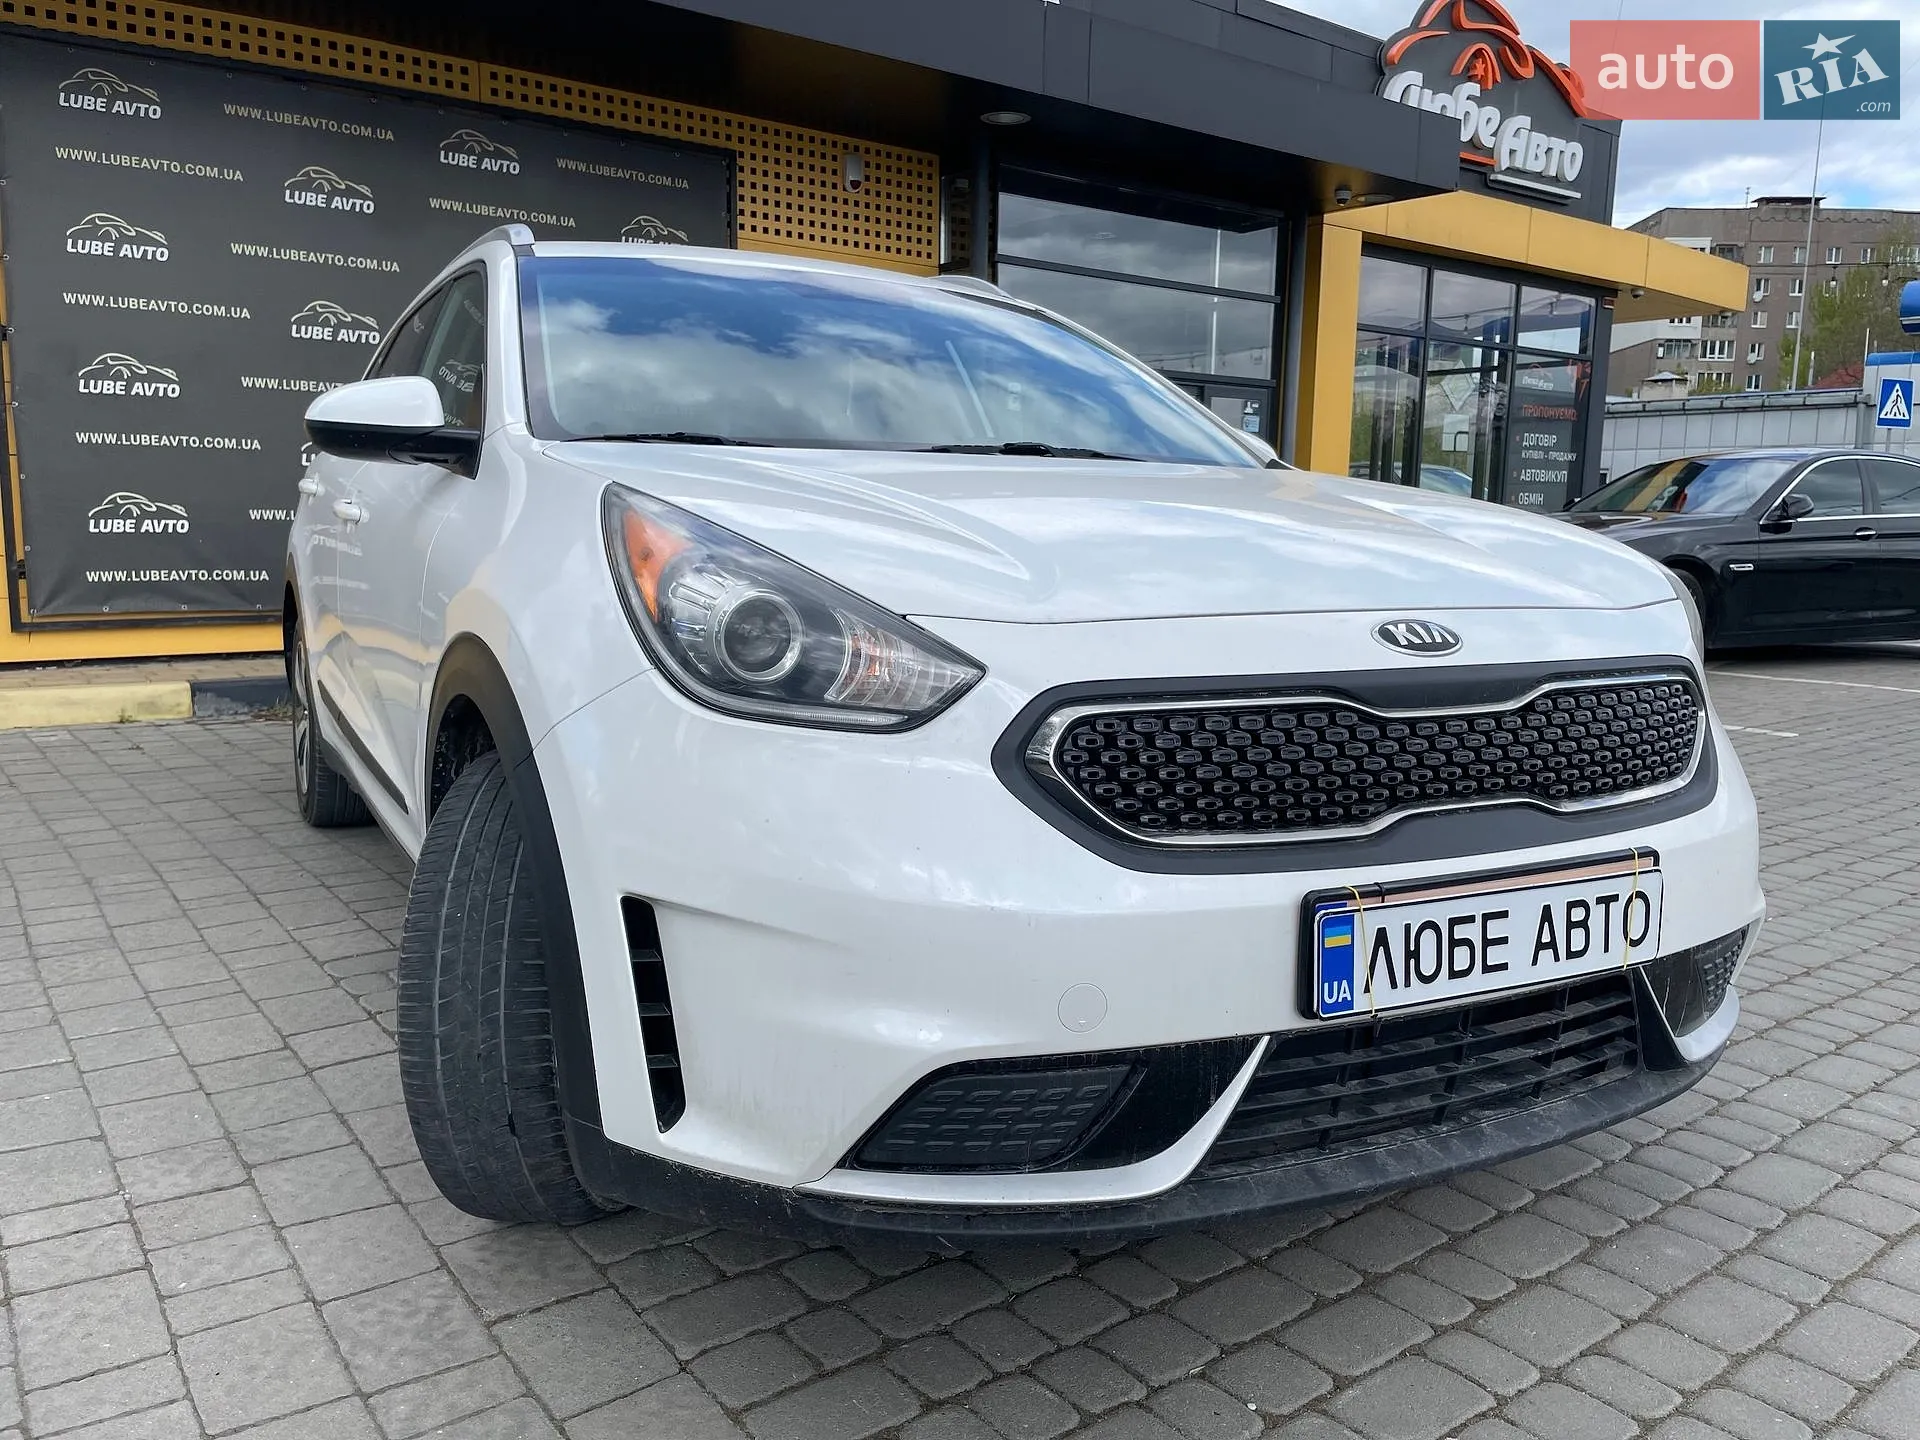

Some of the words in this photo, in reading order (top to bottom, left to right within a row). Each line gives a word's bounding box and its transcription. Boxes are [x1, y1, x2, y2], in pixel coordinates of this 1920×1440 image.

[59, 92, 106, 113] LUBE
[112, 100, 161, 119] AVTO
[224, 103, 394, 142] WWW.LUBEAVTO.COM.UA
[56, 147, 243, 182] WWW.LUBEAVTO.COM.UA
[440, 150, 477, 169] LUBE
[481, 158, 520, 175] AVTO
[556, 158, 689, 190] WWW.LUBEAVTO.COM.UA
[285, 190, 327, 208] LUBE
[331, 197, 375, 214] AVTO
[429, 198, 576, 228] WWW.LUBEAVTO.COM.UA
[67, 239, 114, 257] LUBE
[119, 243, 169, 262] AVTO
[230, 243, 400, 273] WWW.LUBEAVTO.COM.UA
[63, 293, 251, 320] WWW.LUBEAVTO.COM.UA
[291, 325, 333, 341] LUBE
[337, 328, 380, 345] AVTO
[78, 379, 126, 396] LUBE
[131, 382, 180, 398] AVTO
[76, 432, 261, 451] WWW.LUBEAVTO.COM.UA
[1522, 433, 1557, 448] ДОГОВІР
[1520, 469, 1568, 482] АВТОВИКУП
[1518, 492, 1544, 505] ОБМІН
[89, 519, 135, 533] LUBE
[141, 519, 189, 533] AVTO
[86, 569, 269, 582] WWW.LUBEAVTO.COM.UA
[1383, 623, 1456, 645] KIA
[1363, 910, 1510, 994] ЛЮБЕ
[1531, 890, 1651, 967] АВТО
[1323, 981, 1352, 1004] UA
